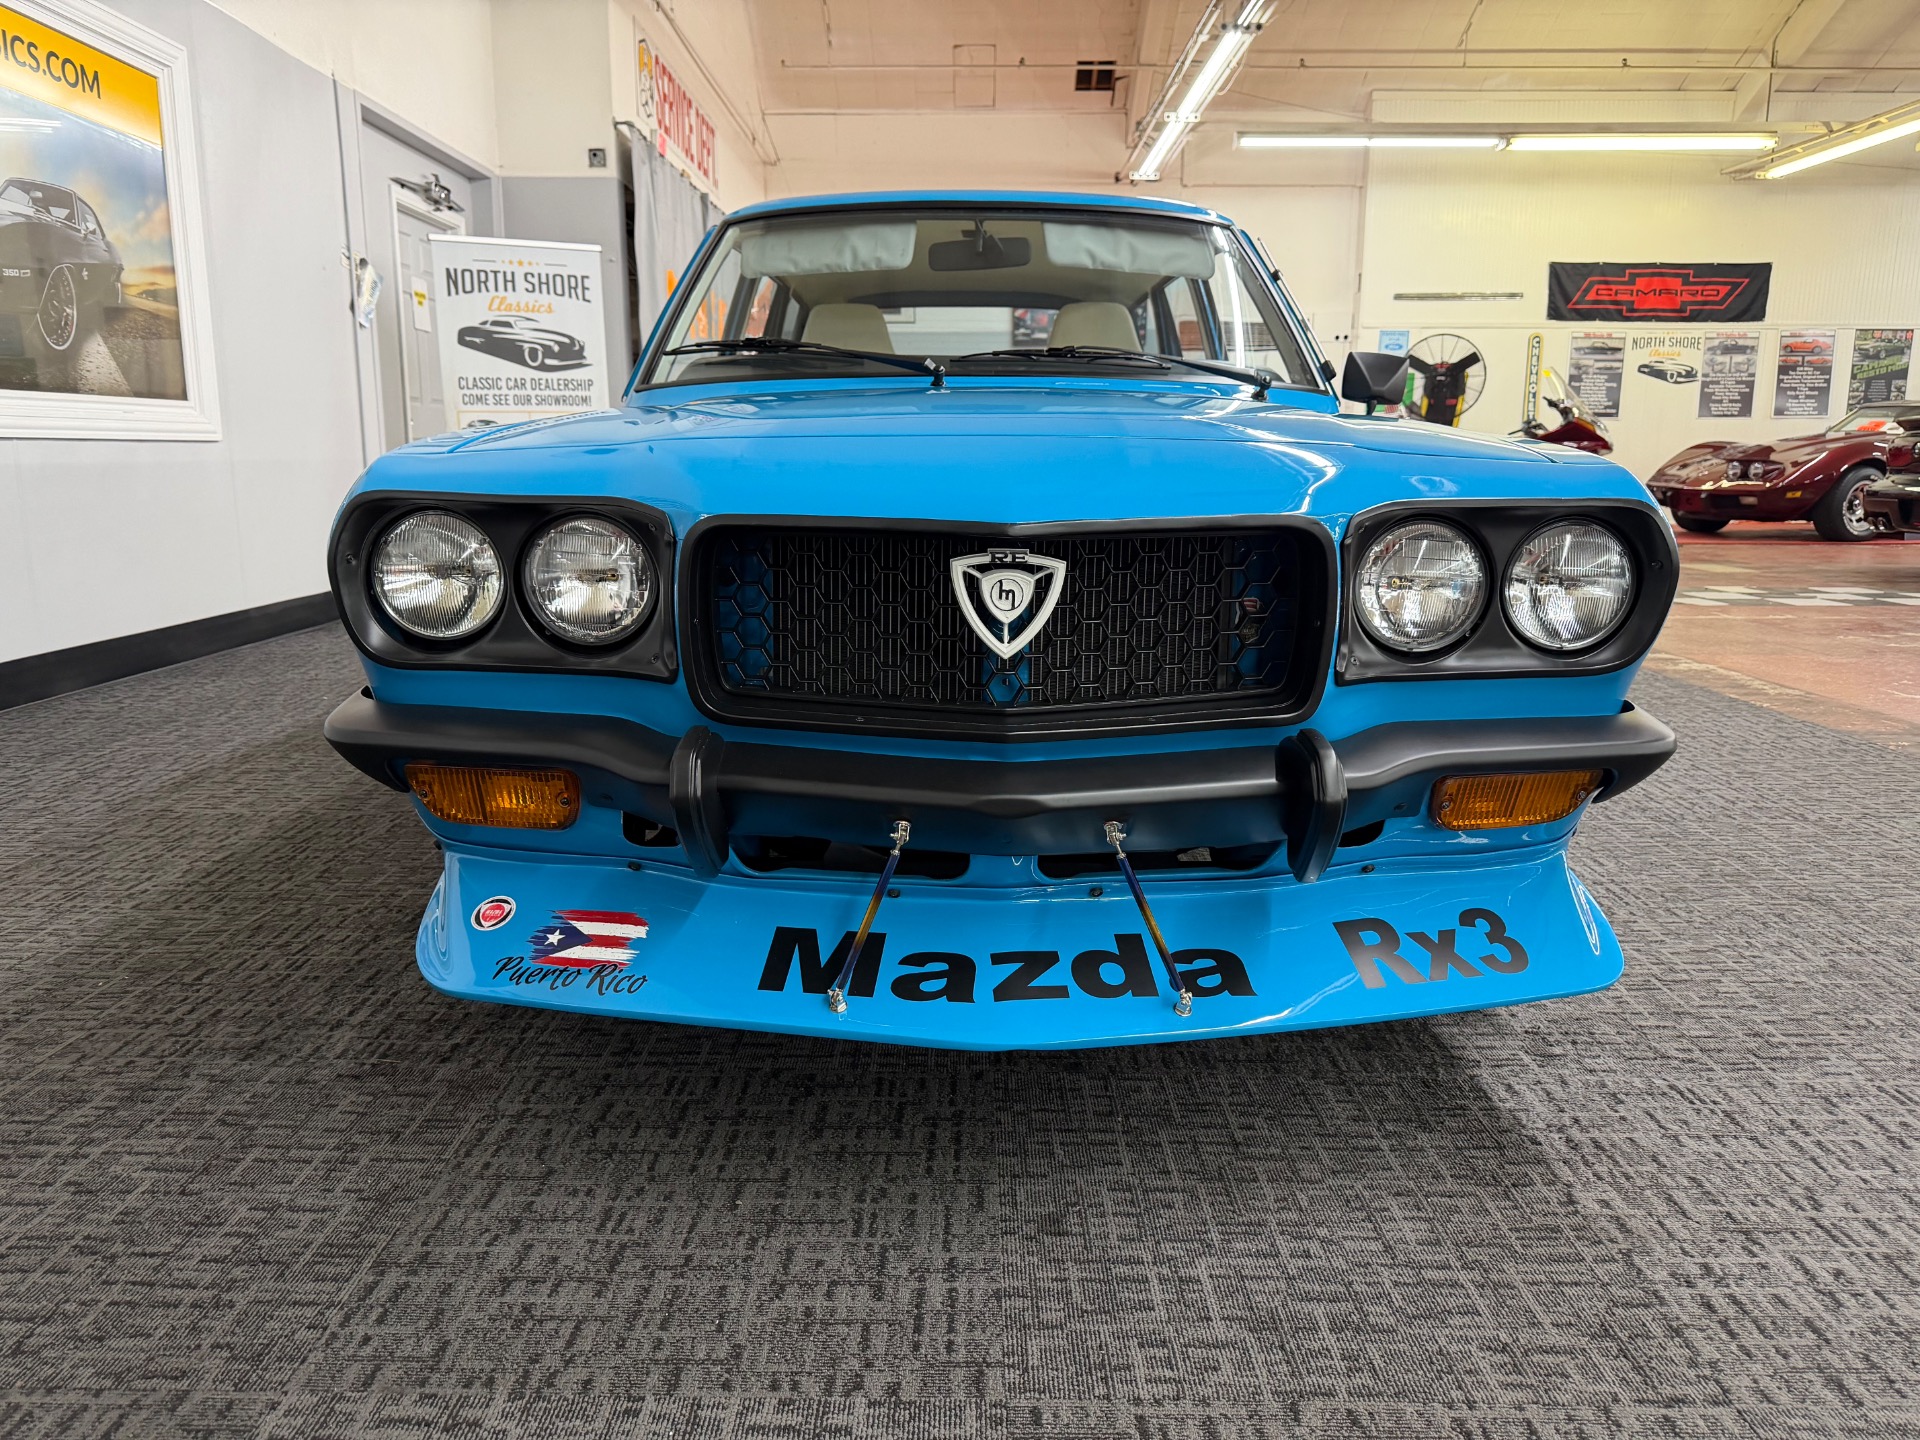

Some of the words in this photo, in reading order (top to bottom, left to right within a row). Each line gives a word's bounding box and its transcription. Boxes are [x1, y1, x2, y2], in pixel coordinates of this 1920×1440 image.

[0, 28, 101, 100] ICS.COM
[2, 268, 20, 277] 350
[445, 267, 516, 297] NORTH
[523, 272, 591, 303] SHORE
[1596, 288, 1720, 297] CAMARO
[488, 295, 554, 314] Classics
[1632, 336, 1666, 350] NORTH
[1668, 337, 1702, 351] SHORE
[458, 376, 503, 391] CLASSIC
[505, 377, 528, 391] CAR
[530, 378, 594, 392] DEALERSHIP
[1527, 337, 1541, 419] CHEVROLET
[462, 393, 490, 406] COME
[492, 393, 511, 406] SEE
[512, 394, 533, 407] OUR
[534, 394, 593, 407] SHOWROOM!
[990, 552, 1029, 563] RE
[1332, 907, 1529, 990] Rx3
[757, 926, 1259, 1004] Mazda
[492, 956, 582, 990] Puerto
[586, 963, 648, 996] Rico
